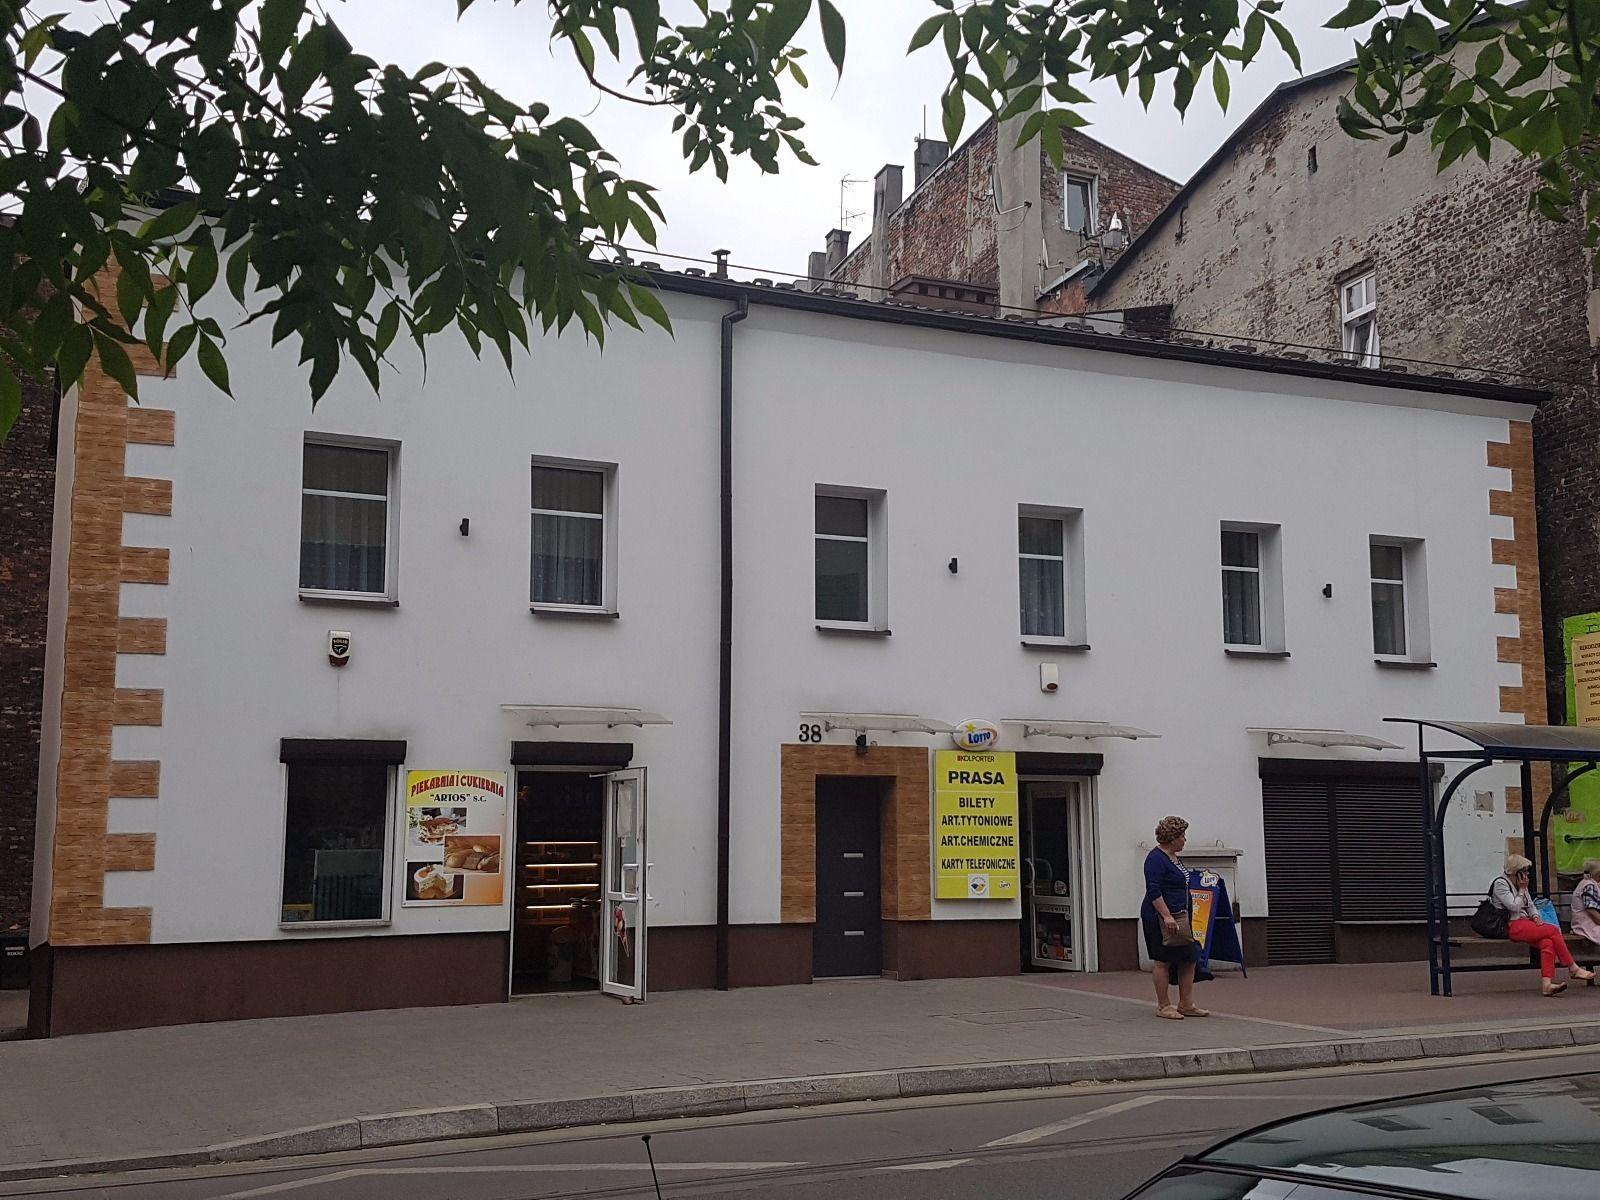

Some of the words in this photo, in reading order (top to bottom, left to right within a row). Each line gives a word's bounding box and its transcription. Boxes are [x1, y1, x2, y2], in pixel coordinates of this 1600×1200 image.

[799, 724, 822, 743] 38
[948, 771, 1005, 785] PRASA
[411, 775, 456, 797] PIEKARNIA
[456, 775, 460, 786] I
[460, 775, 504, 797] CUKIERNIA
[959, 797, 995, 808] BILETY
[941, 815, 1013, 827] ART.TYTONIOWE
[941, 835, 1014, 847] ART.CHEMICZNE
[941, 858, 964, 870] KARTY
[965, 859, 1016, 870] TELEFONICZNE
